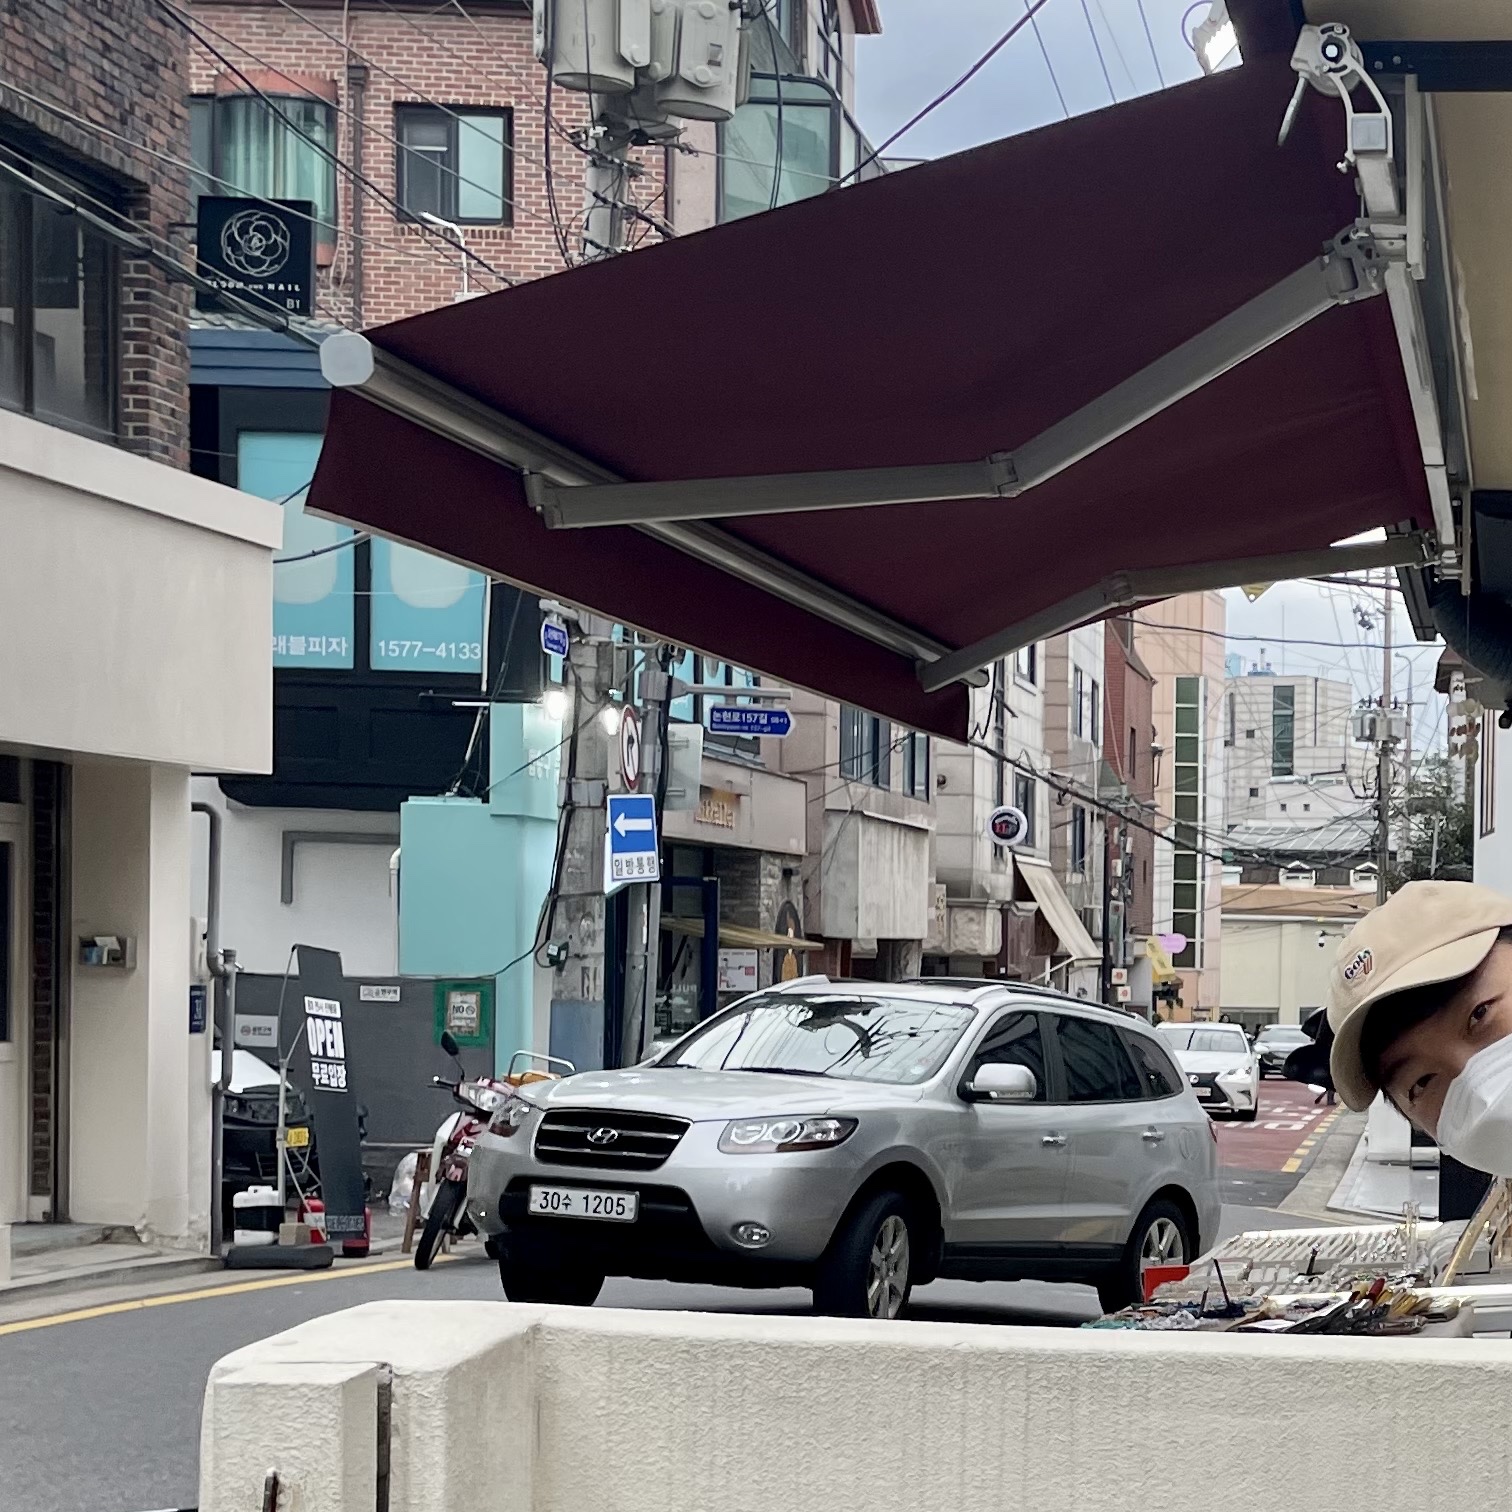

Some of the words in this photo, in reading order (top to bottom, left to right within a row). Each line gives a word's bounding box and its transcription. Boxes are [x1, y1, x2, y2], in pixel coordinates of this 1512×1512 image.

[378, 639, 481, 660] 1577-4133
[614, 856, 656, 877] 일방통행
[452, 1004, 464, 1015] NO
[306, 1016, 345, 1059] OPEN
[311, 1062, 347, 1088] 무료입장
[539, 1190, 572, 1211] 30수
[582, 1194, 626, 1216] 1205
